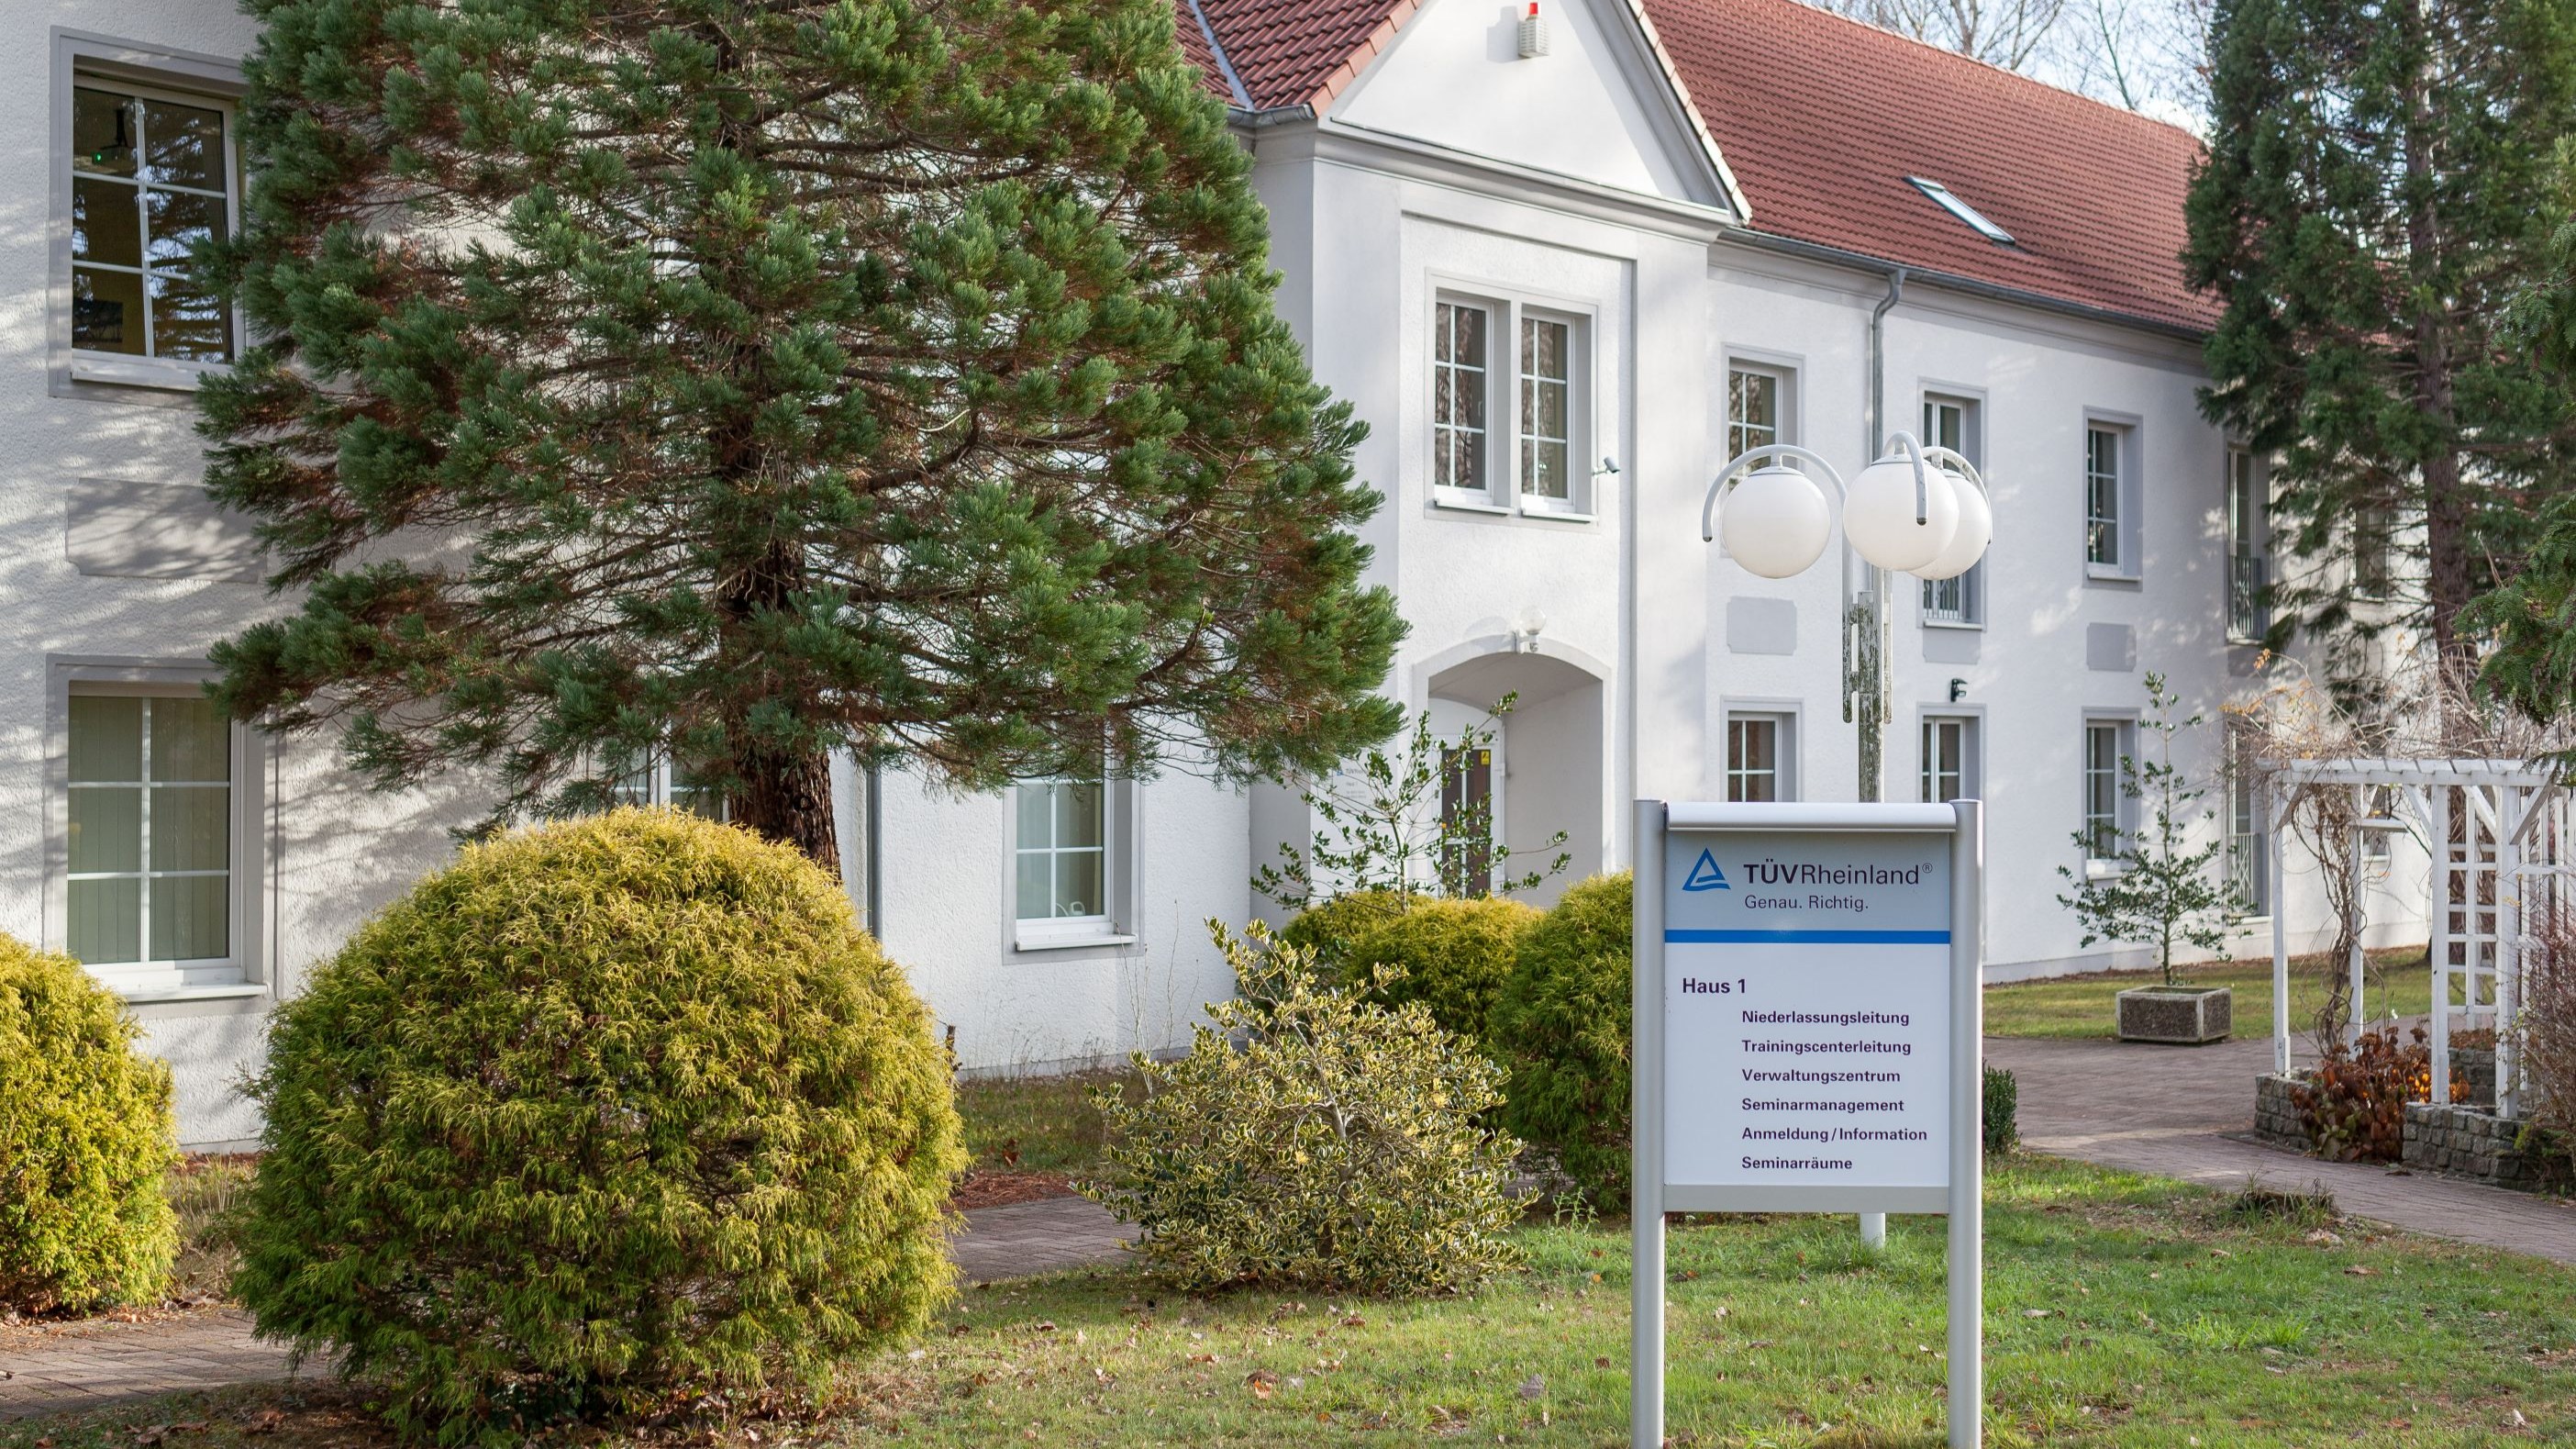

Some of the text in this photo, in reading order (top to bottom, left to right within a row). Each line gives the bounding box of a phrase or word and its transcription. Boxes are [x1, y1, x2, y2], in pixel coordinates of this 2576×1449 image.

[1744, 894, 1869, 912] Genau. Richtig.
[1682, 978, 1746, 995] Haus 1
[1742, 1009, 1910, 1027] Niederlassungsleitung
[1742, 1039, 1912, 1056] Trainingscenterleitung
[1742, 1068, 1901, 1085] Verwaltungszentrum
[1742, 1098, 1904, 1114] Seminarmanagement
[1742, 1155, 1853, 1170] Seminarräume
